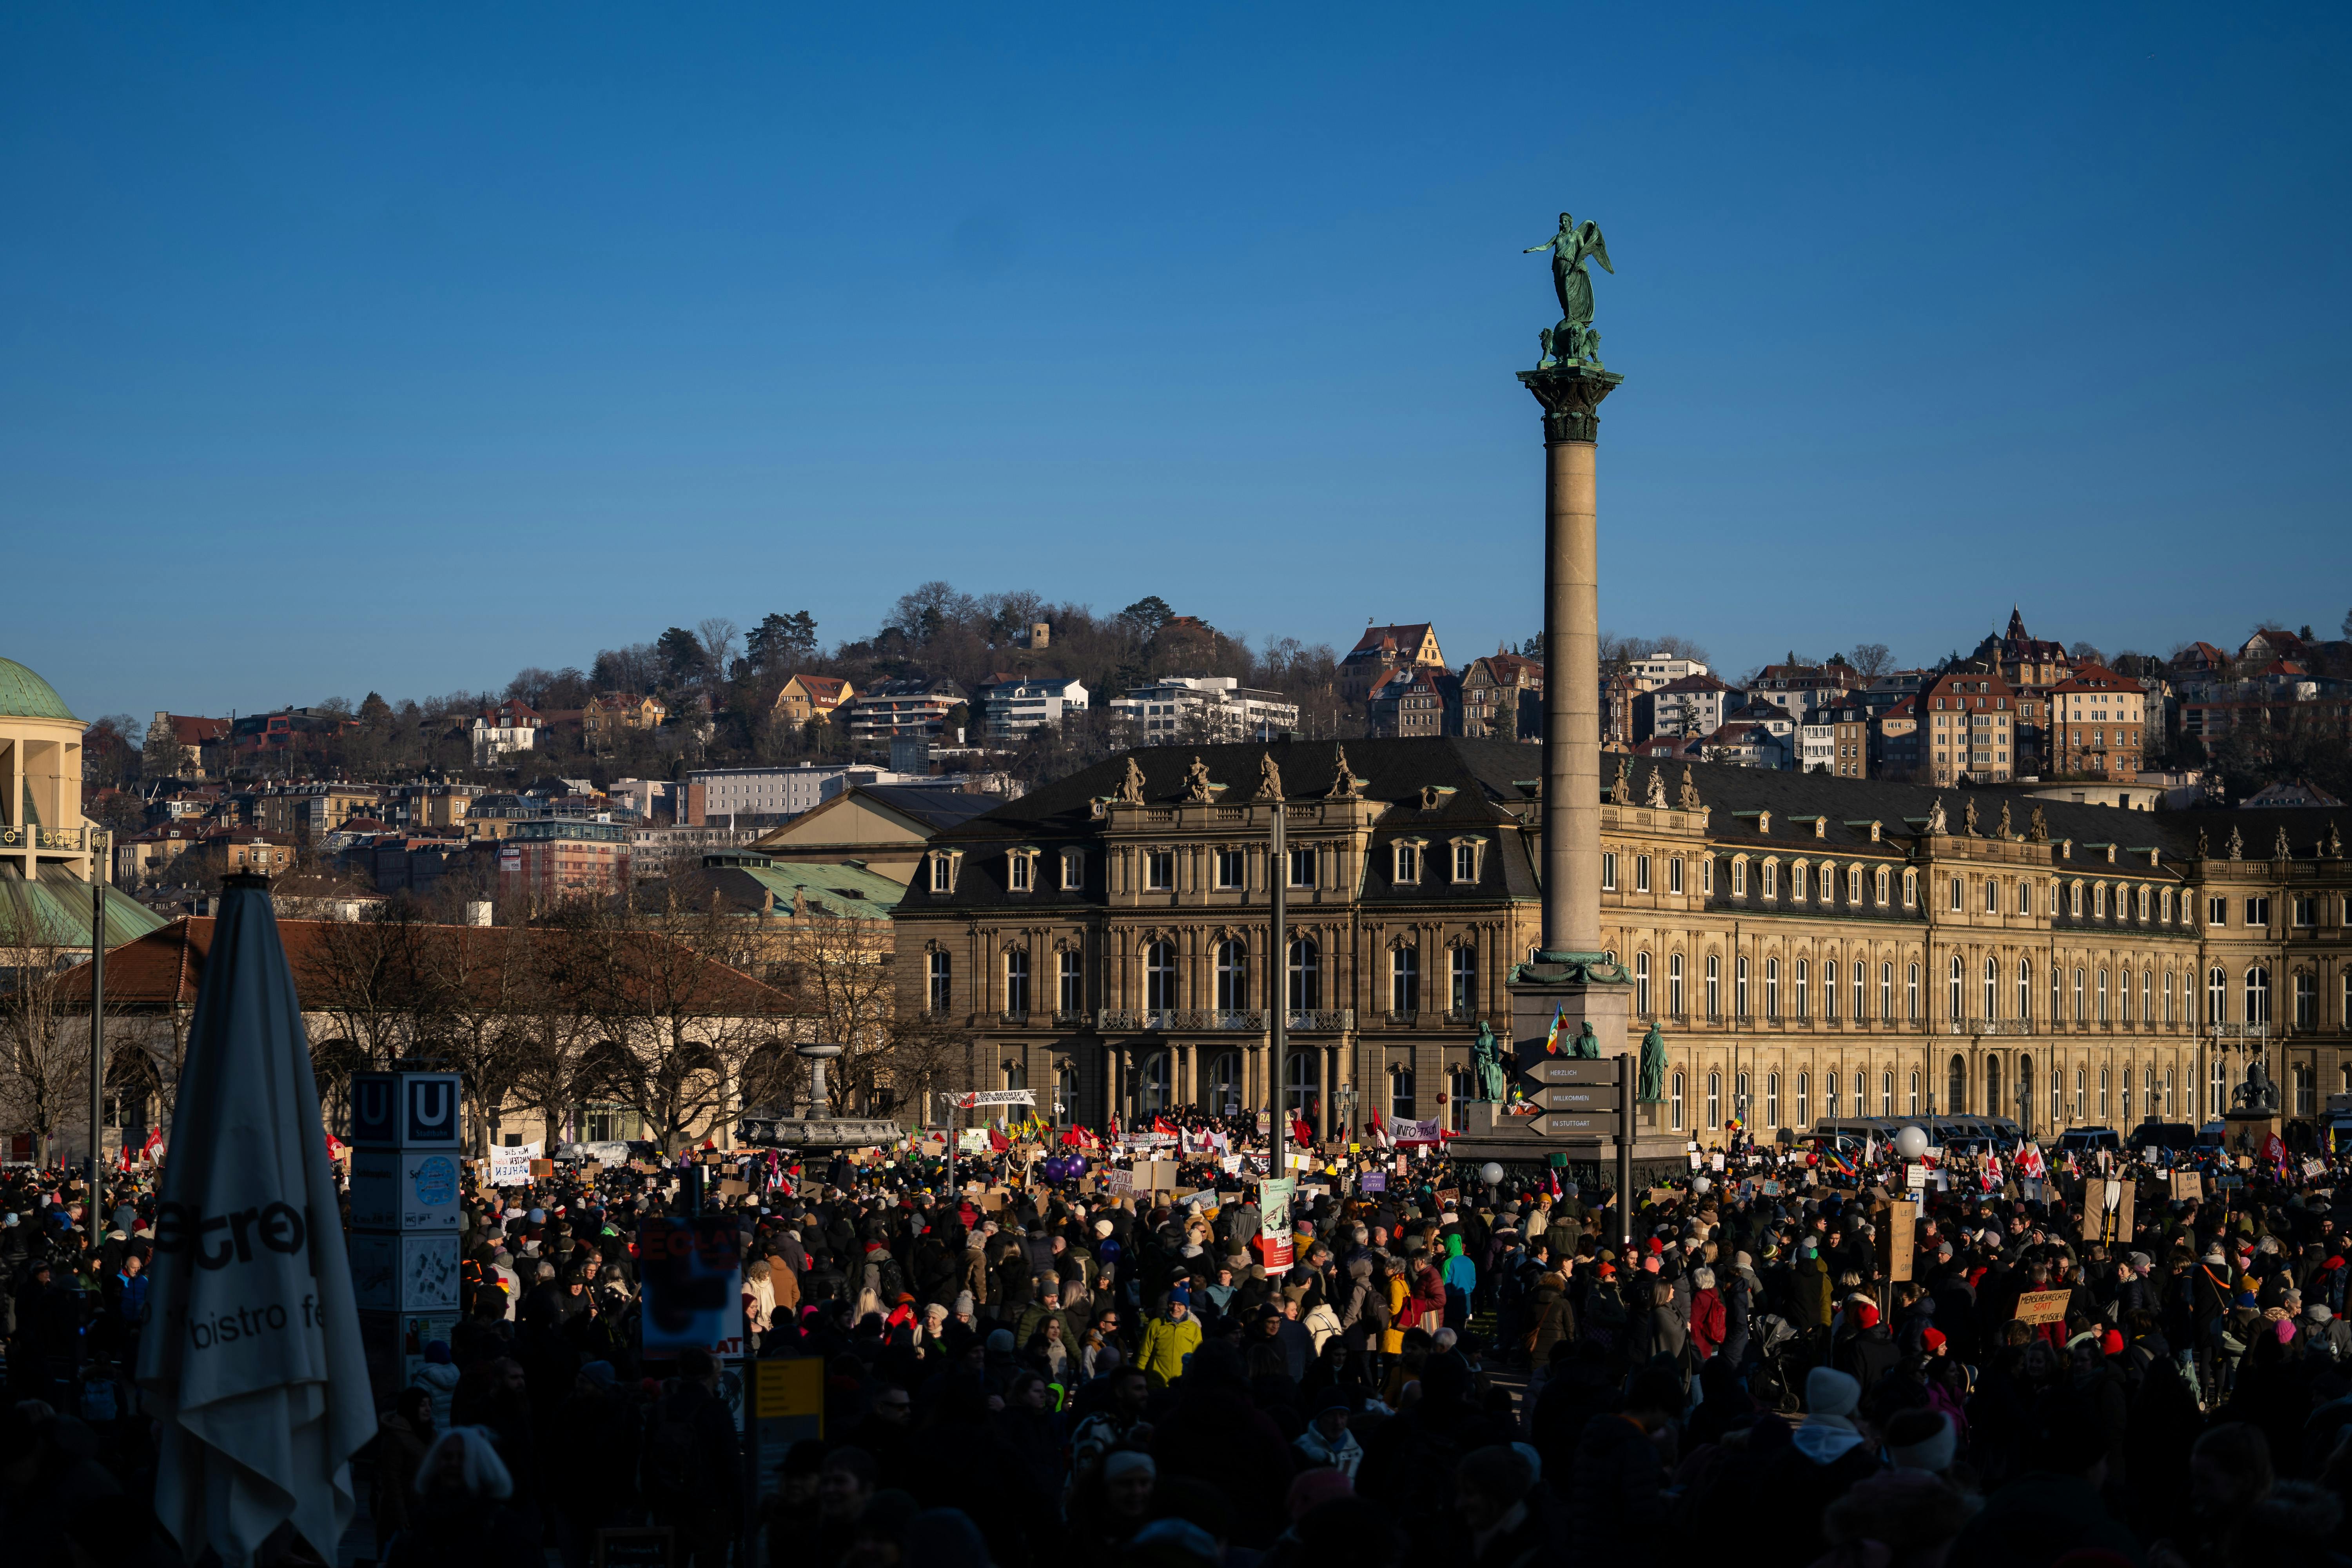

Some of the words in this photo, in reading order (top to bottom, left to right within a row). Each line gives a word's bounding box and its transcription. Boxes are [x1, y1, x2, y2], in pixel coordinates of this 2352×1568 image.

[361, 1083, 387, 1125] U
[417, 1083, 448, 1126] U
[2020, 1291, 2071, 1305] MENSCHENRECHTE
[2033, 1302, 2052, 1311] STATT
[190, 1304, 287, 1349] bistro
[2039, 1312, 2065, 1322] MENSCHEN
